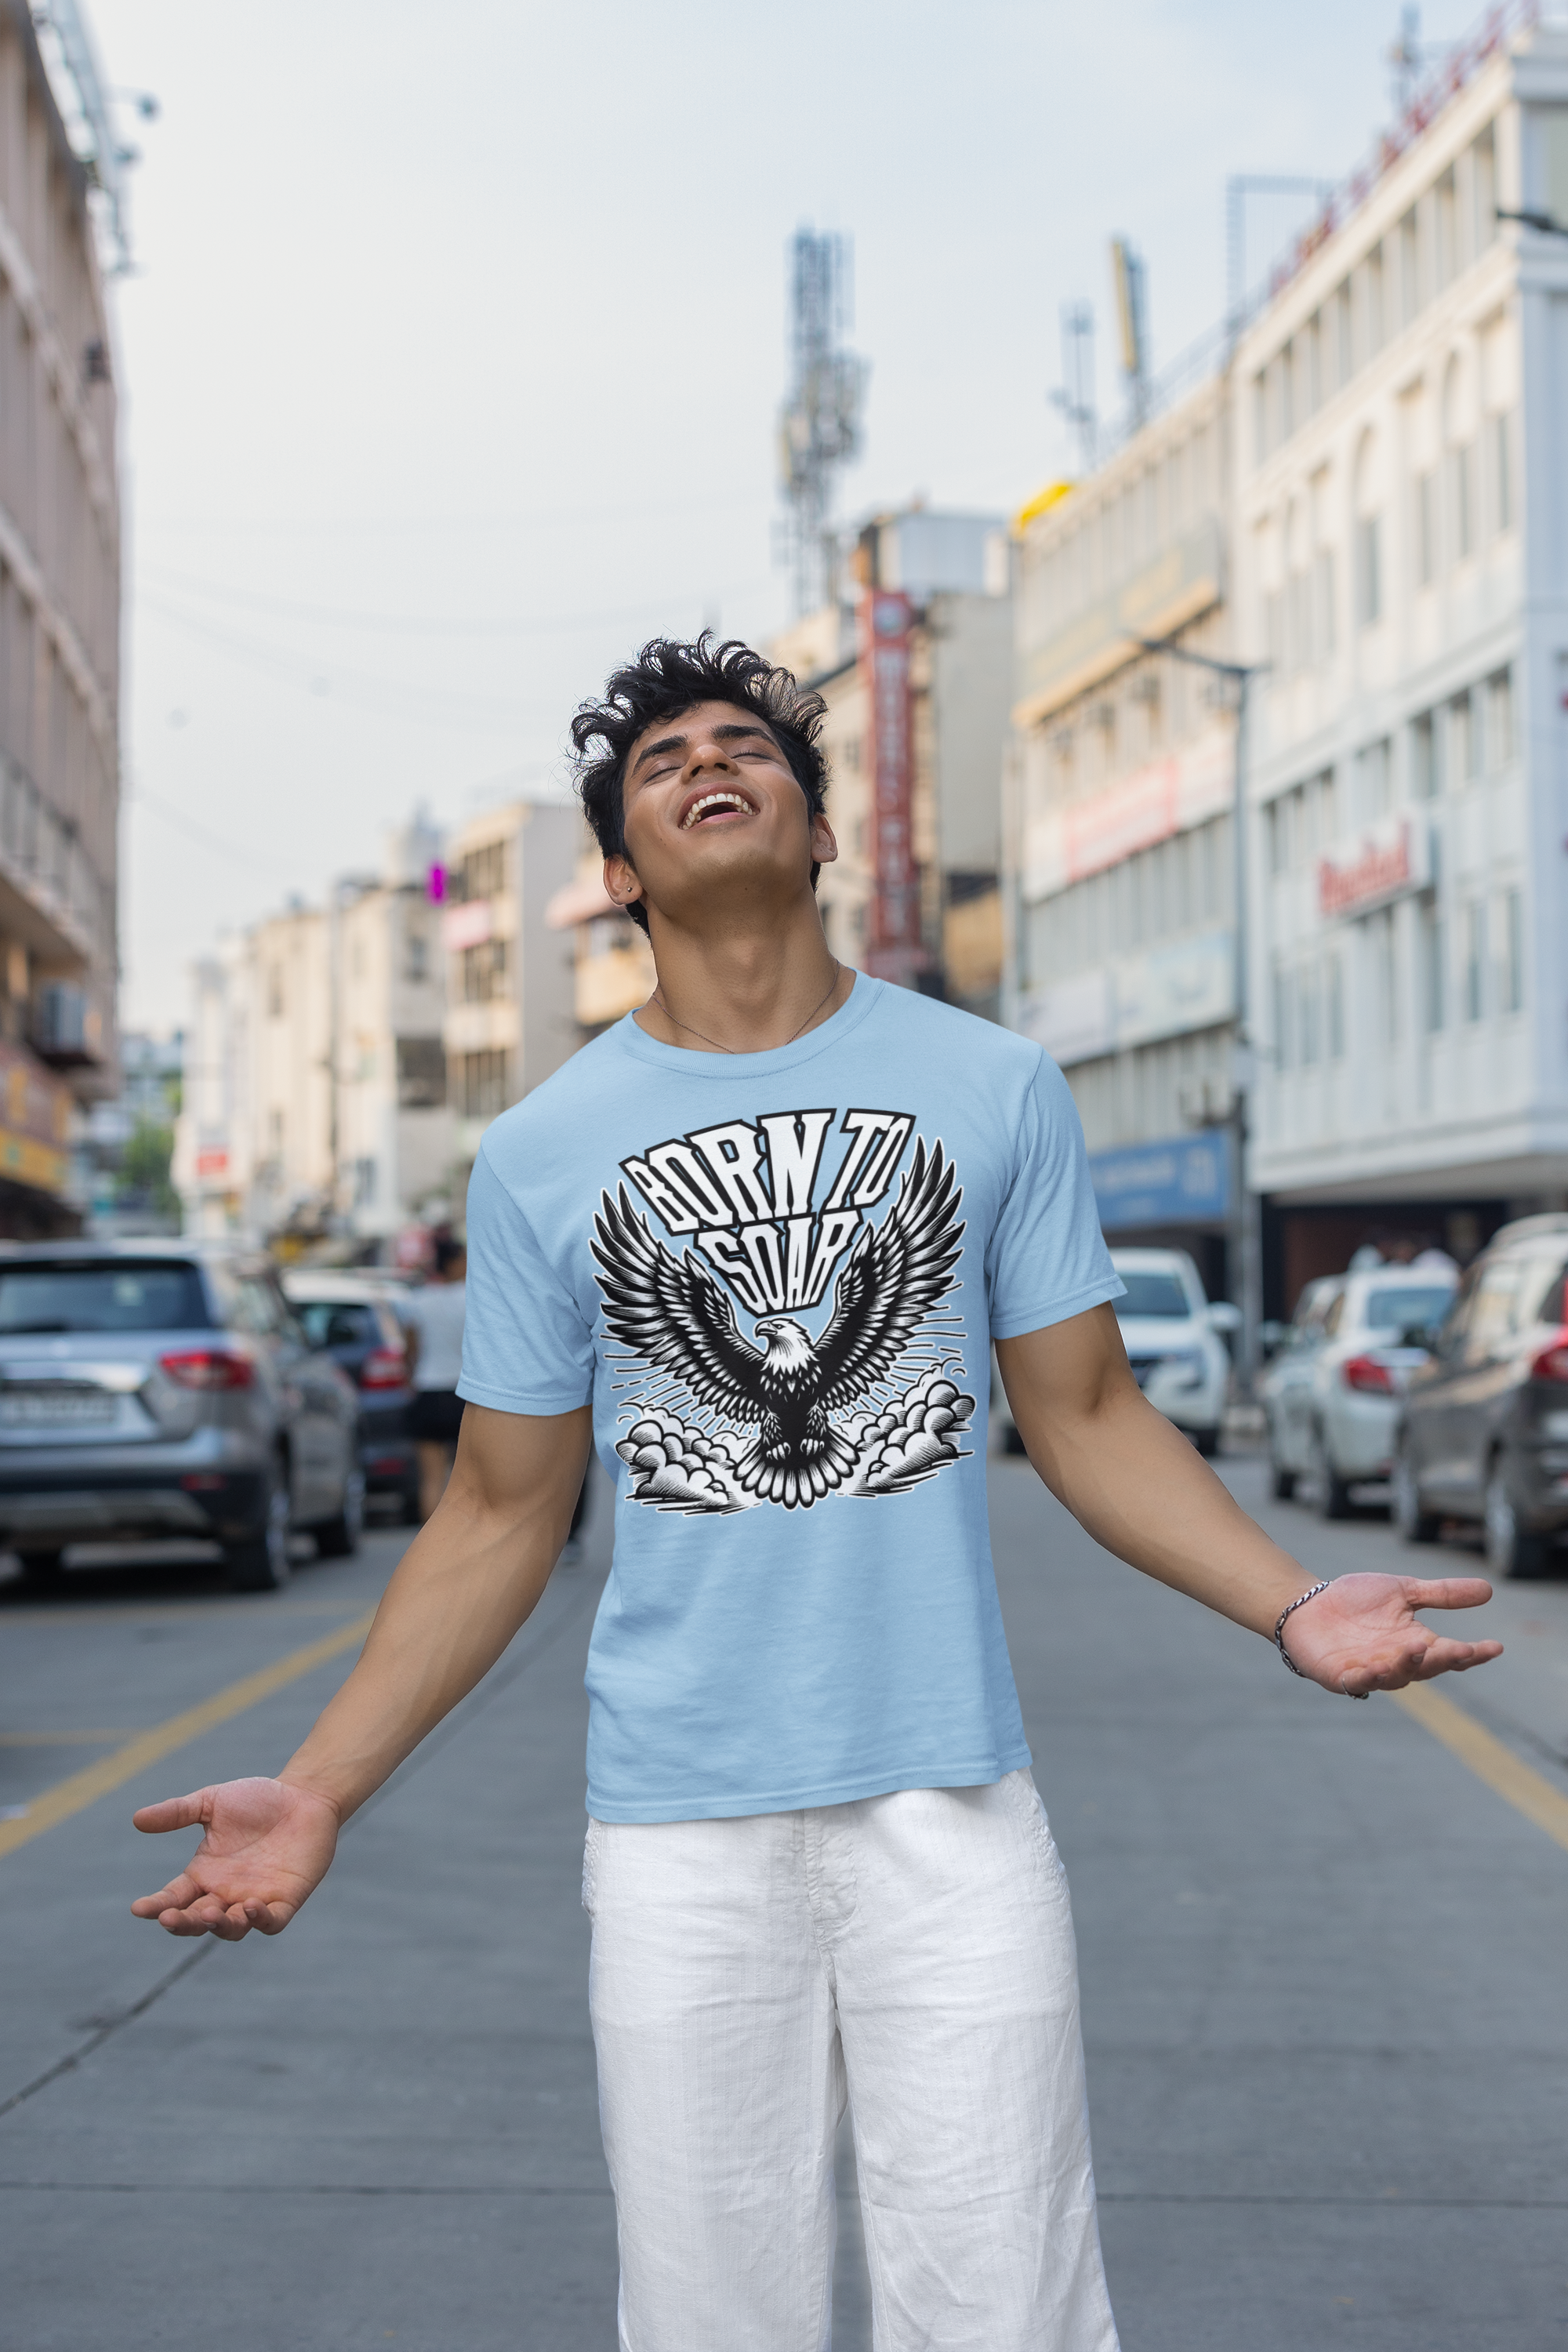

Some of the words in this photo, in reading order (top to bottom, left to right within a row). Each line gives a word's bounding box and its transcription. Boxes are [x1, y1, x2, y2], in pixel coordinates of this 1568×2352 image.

[619, 1109, 837, 1236] BORN
[821, 1109, 916, 1213] TO
[695, 1209, 864, 1317] SOAR
